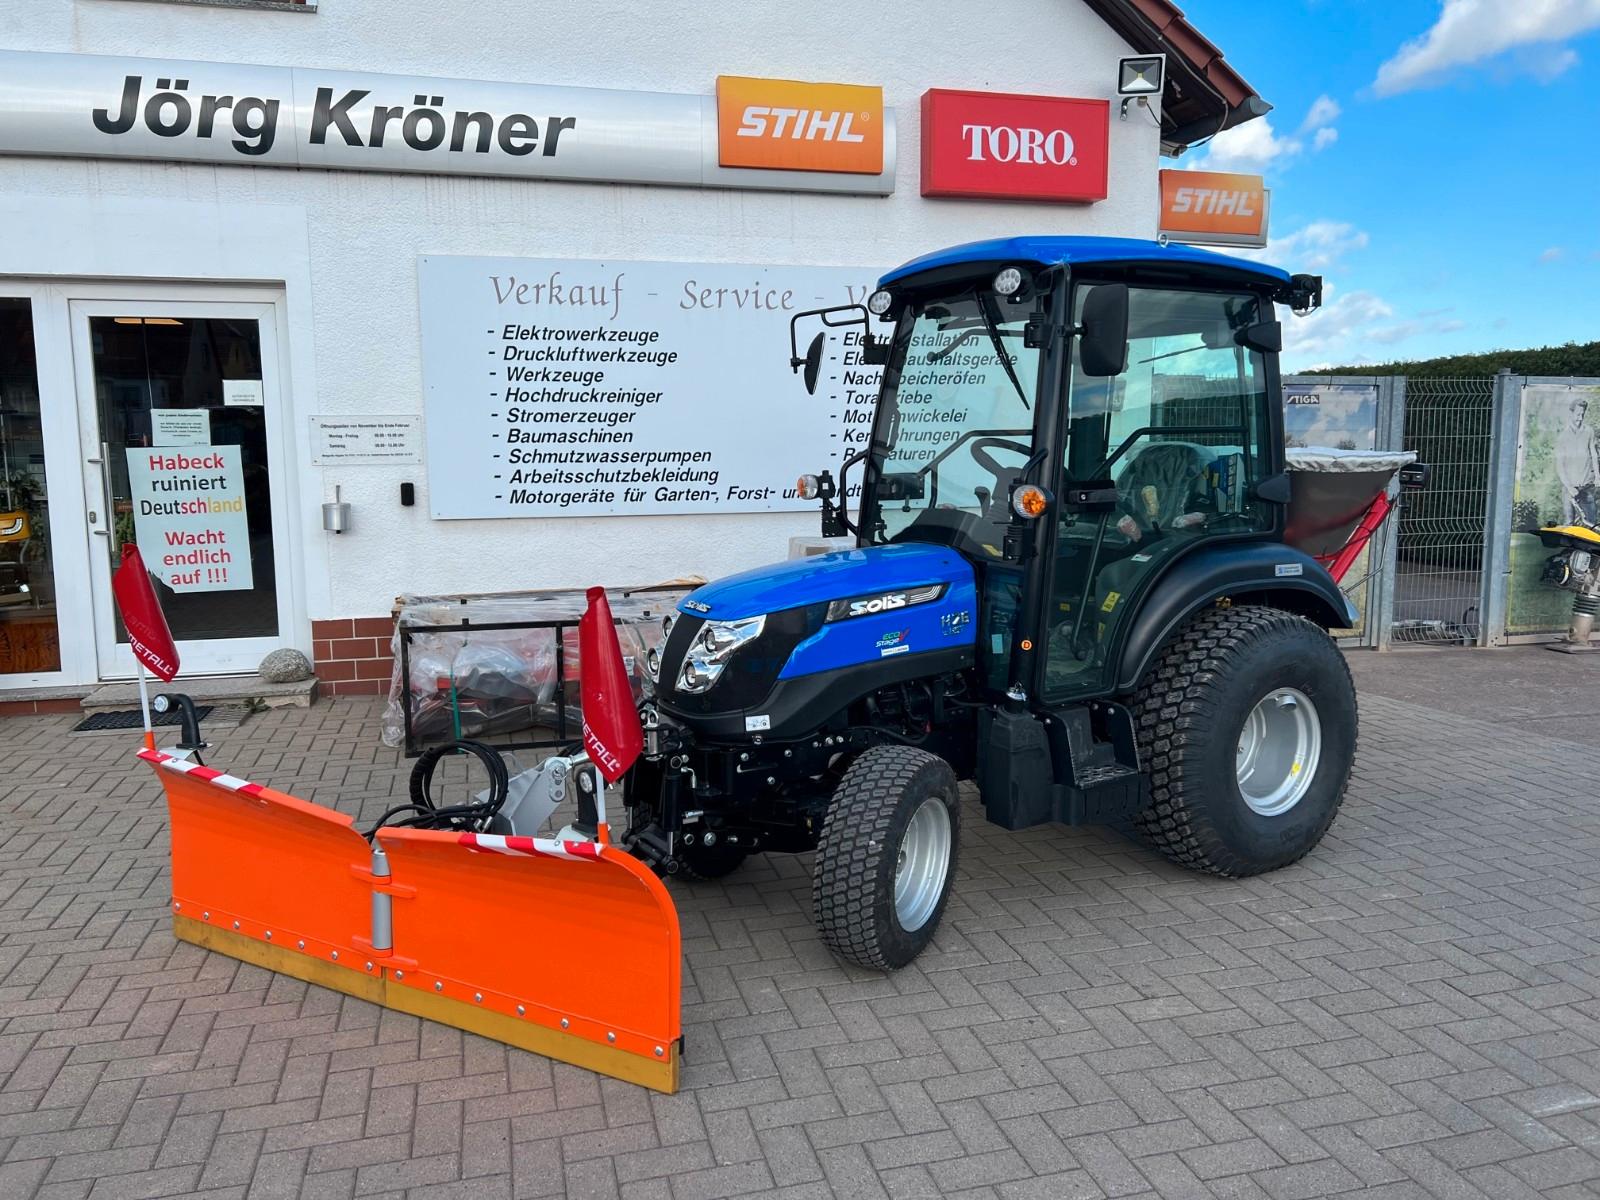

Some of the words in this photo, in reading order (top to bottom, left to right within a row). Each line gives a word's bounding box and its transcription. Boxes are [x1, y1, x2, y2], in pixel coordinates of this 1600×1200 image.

[91, 75, 281, 156] Jörg
[308, 87, 577, 157] Kröner
[489, 271, 625, 321] Verkauf
[679, 280, 795, 310] Service
[502, 324, 659, 346] Elektrowerkzeuge
[503, 345, 678, 367] Druckluftwerkzeuge
[506, 366, 604, 386] Werkzeuge
[505, 387, 663, 407] Hochdruckreiniger
[1287, 395, 1319, 404] STIGA
[506, 407, 636, 427] Stromerzeuger
[507, 428, 634, 443] Baumaschinen
[149, 452, 225, 471] Habeck
[508, 448, 712, 467] Schmutzwasserpumpen
[152, 475, 227, 492] ruiniert
[509, 468, 719, 485] Arbeitsschutzbekleidung
[509, 488, 615, 507] Motorgeräte
[623, 488, 647, 503] für
[727, 485, 776, 501] Forst-
[140, 496, 243, 516] Deutschland
[164, 529, 226, 546] Wacht
[163, 548, 231, 566] endlich
[171, 569, 201, 586] auf
[207, 567, 228, 583] !!!
